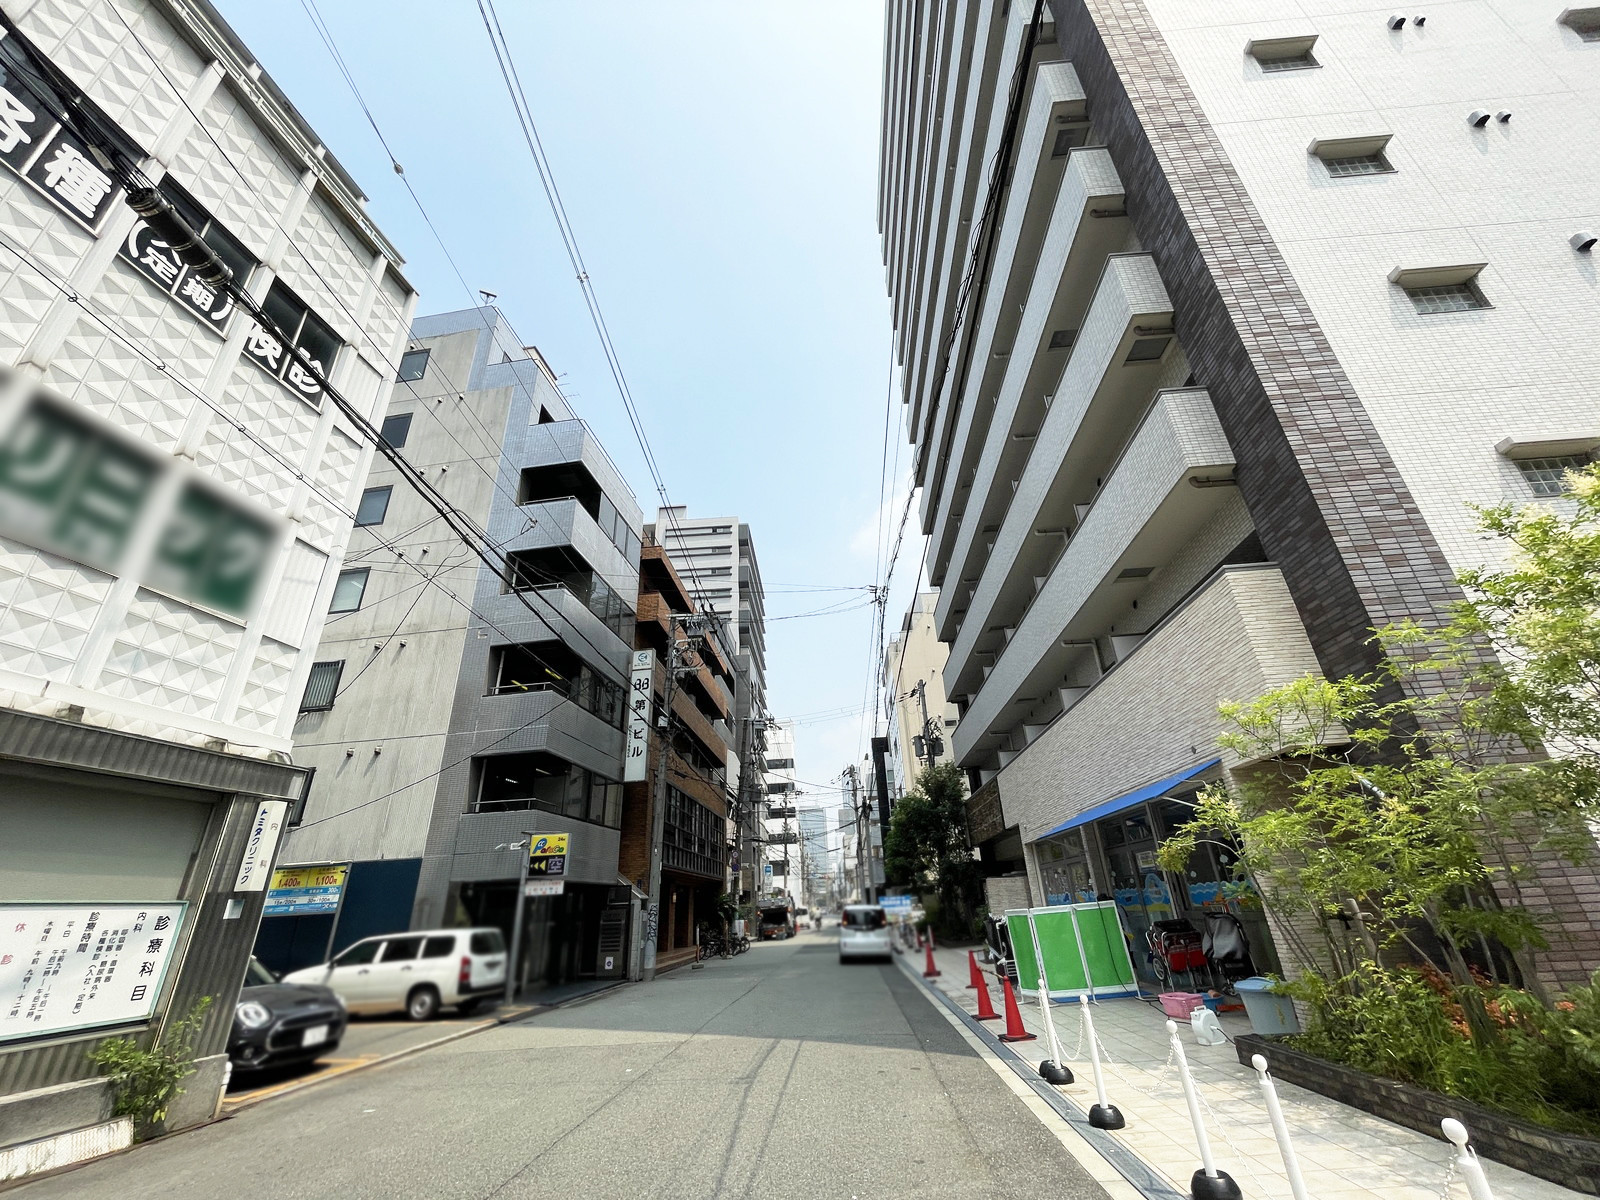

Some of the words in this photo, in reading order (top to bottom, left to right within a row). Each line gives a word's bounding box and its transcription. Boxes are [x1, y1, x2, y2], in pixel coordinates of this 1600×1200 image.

[241, 808, 268, 885] トミタクリニック
[76, 911, 101, 954] 診療時間
[133, 911, 148, 933] 内科
[130, 915, 172, 1002] 診療科目
